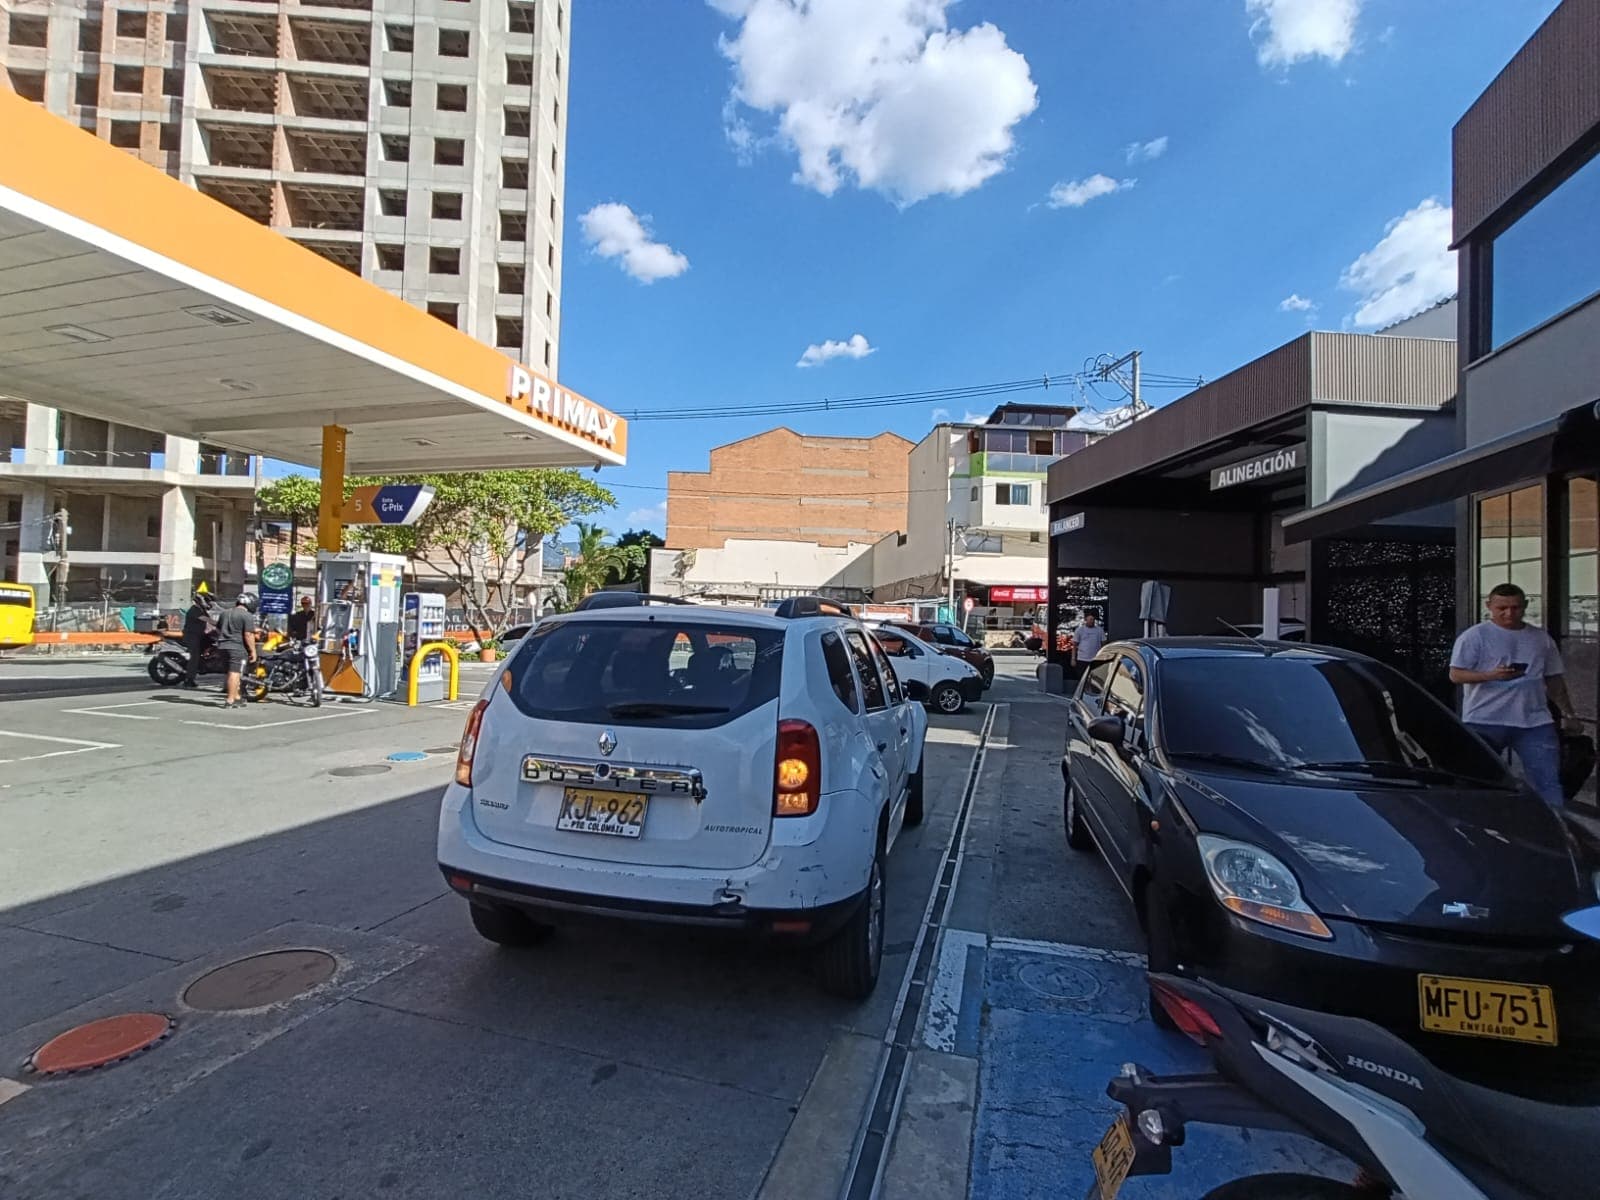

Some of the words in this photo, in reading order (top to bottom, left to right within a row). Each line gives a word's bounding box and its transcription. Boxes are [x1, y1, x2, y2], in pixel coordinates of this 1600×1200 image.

[510, 364, 618, 445] PRIMAX
[336, 441, 343, 453] 3
[1218, 450, 1296, 488] ALINEACIÓN
[355, 500, 362, 512] 5
[381, 503, 404, 512] G-Prix
[524, 766, 690, 794] DUSTER
[587, 822, 625, 834] COLOMBIA
[703, 823, 763, 836] AUTOTROPICAL
[1459, 1021, 1517, 1037] ENVIGADO
[1346, 1055, 1424, 1091] HONDA
